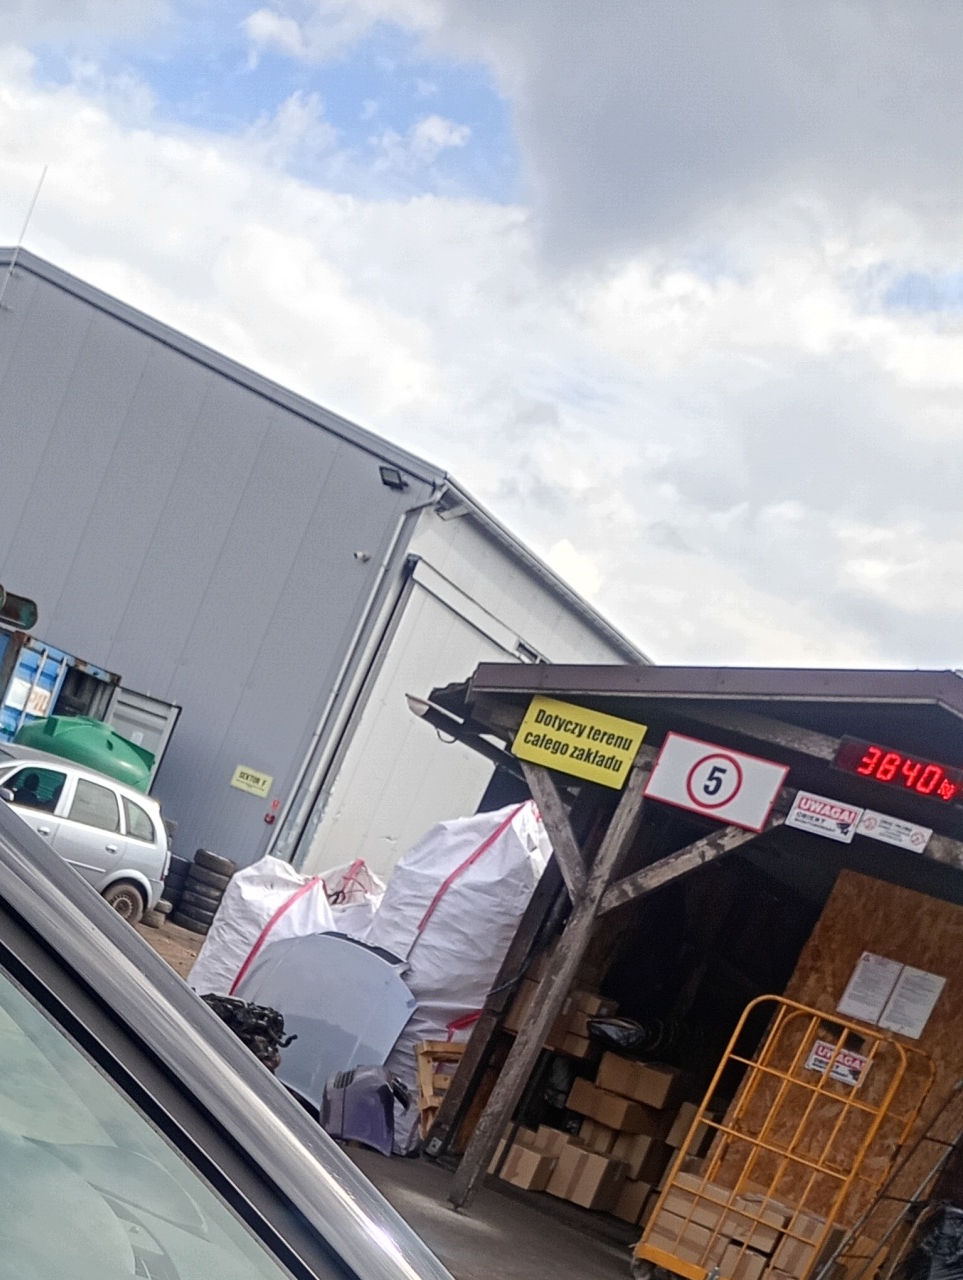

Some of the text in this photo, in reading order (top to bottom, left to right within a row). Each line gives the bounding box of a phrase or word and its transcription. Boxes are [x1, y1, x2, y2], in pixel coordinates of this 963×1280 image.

[534, 708, 634, 752] Dotyczy terenu
[523, 731, 624, 773] całego zakładu
[703, 766, 727, 795] 5
[798, 797, 857, 823] UWAGA!
